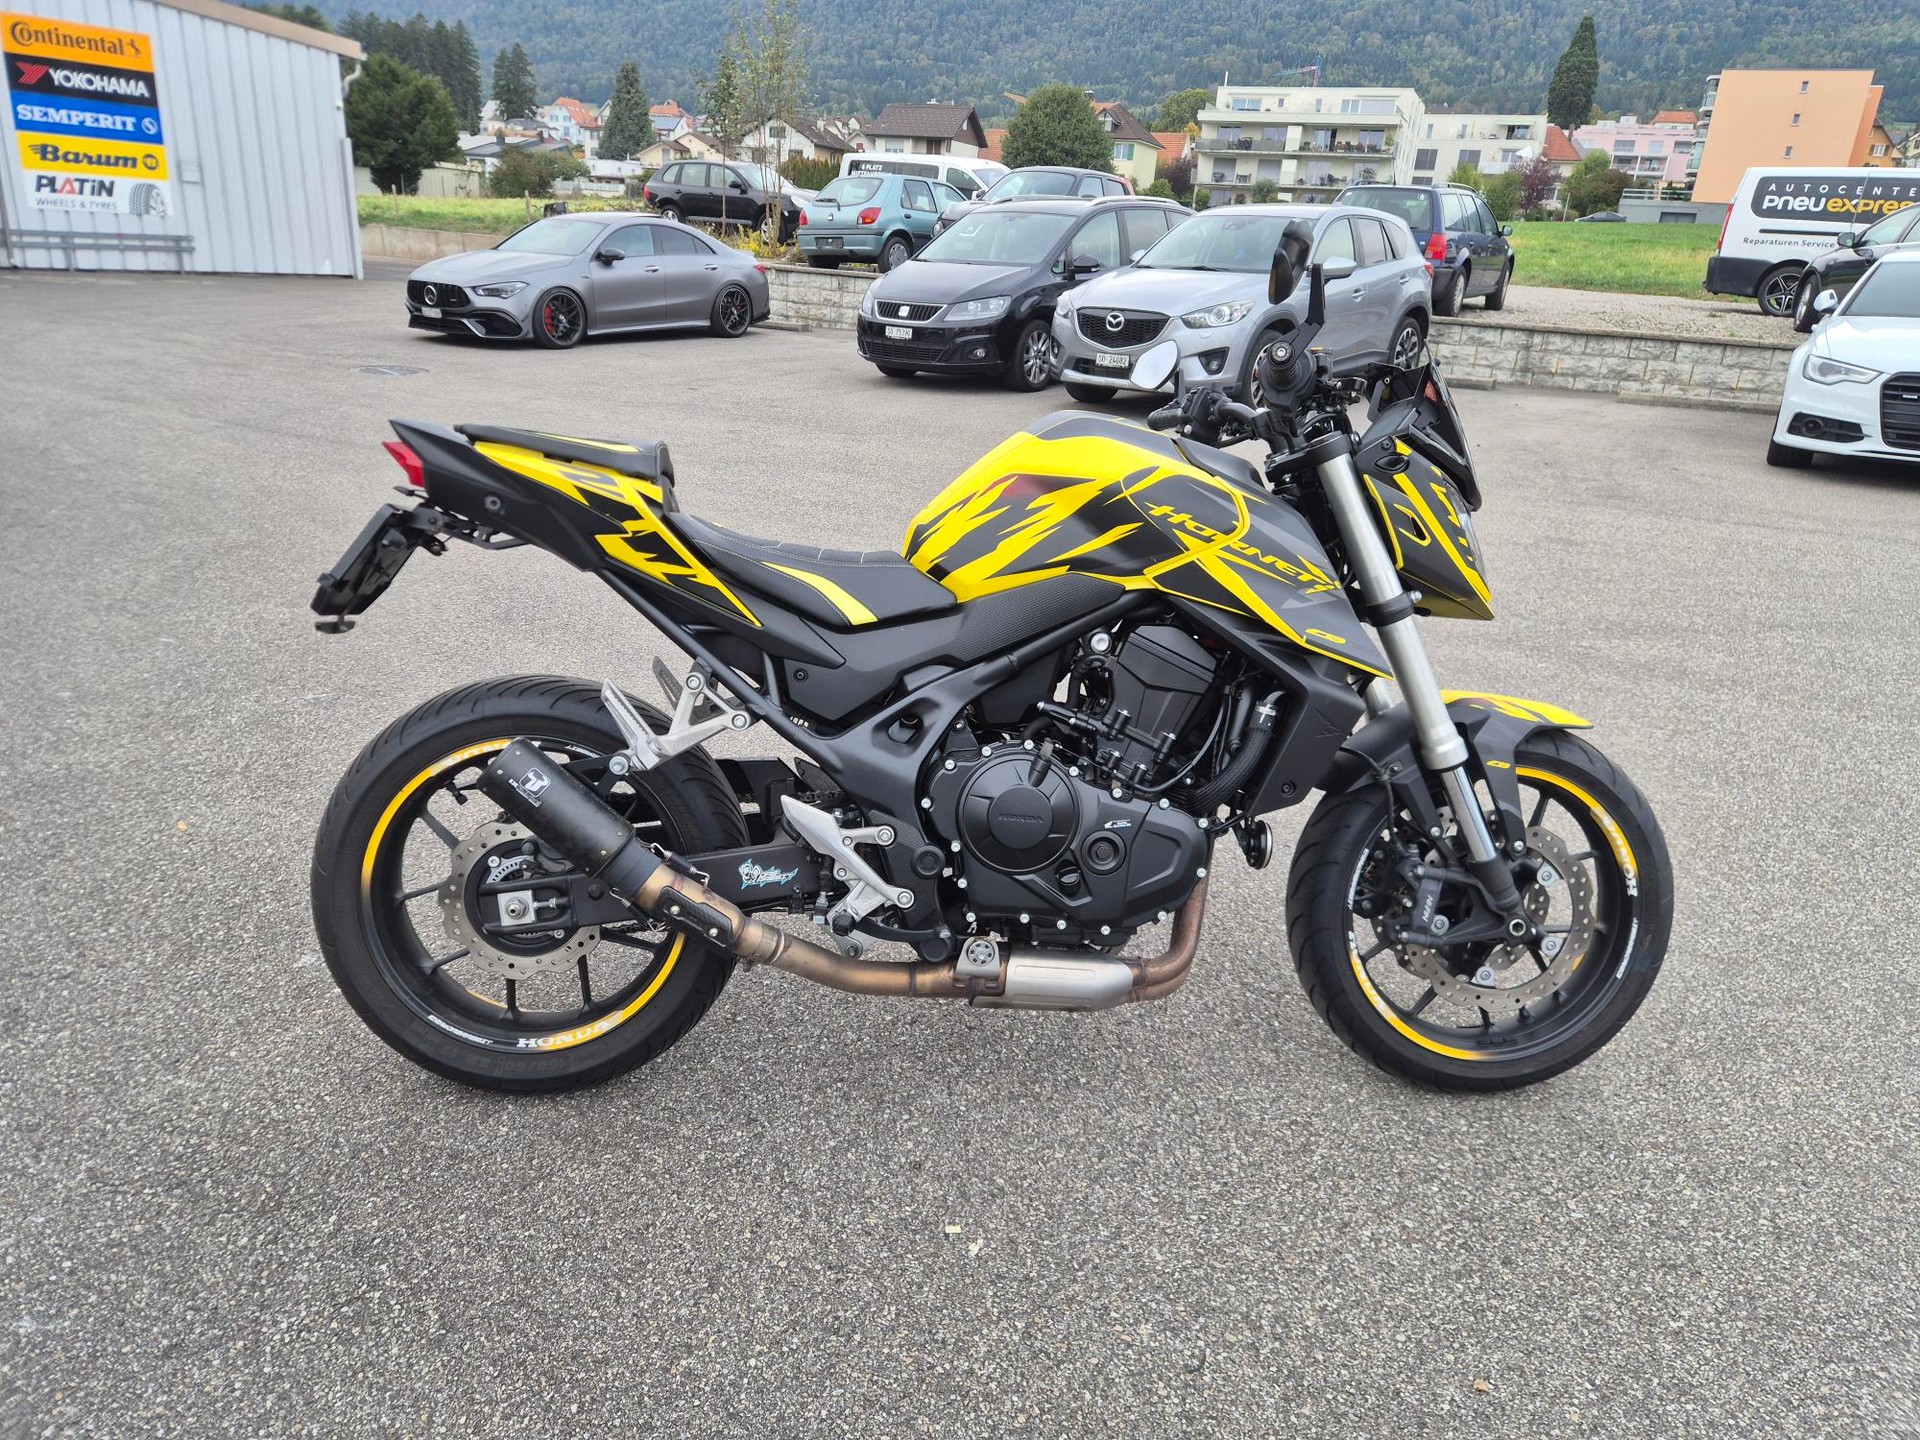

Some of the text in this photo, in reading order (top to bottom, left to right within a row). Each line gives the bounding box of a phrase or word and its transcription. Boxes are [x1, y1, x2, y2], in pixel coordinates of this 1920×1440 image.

[10, 21, 126, 56] Continental
[49, 67, 150, 98] YOKOHAMA
[16, 103, 137, 132] SEMPERIT
[31, 143, 138, 169] Barum
[35, 197, 77, 209] WHEELS
[89, 201, 118, 211] TYRES
[1742, 237, 1836, 248] Reparaturen Service
